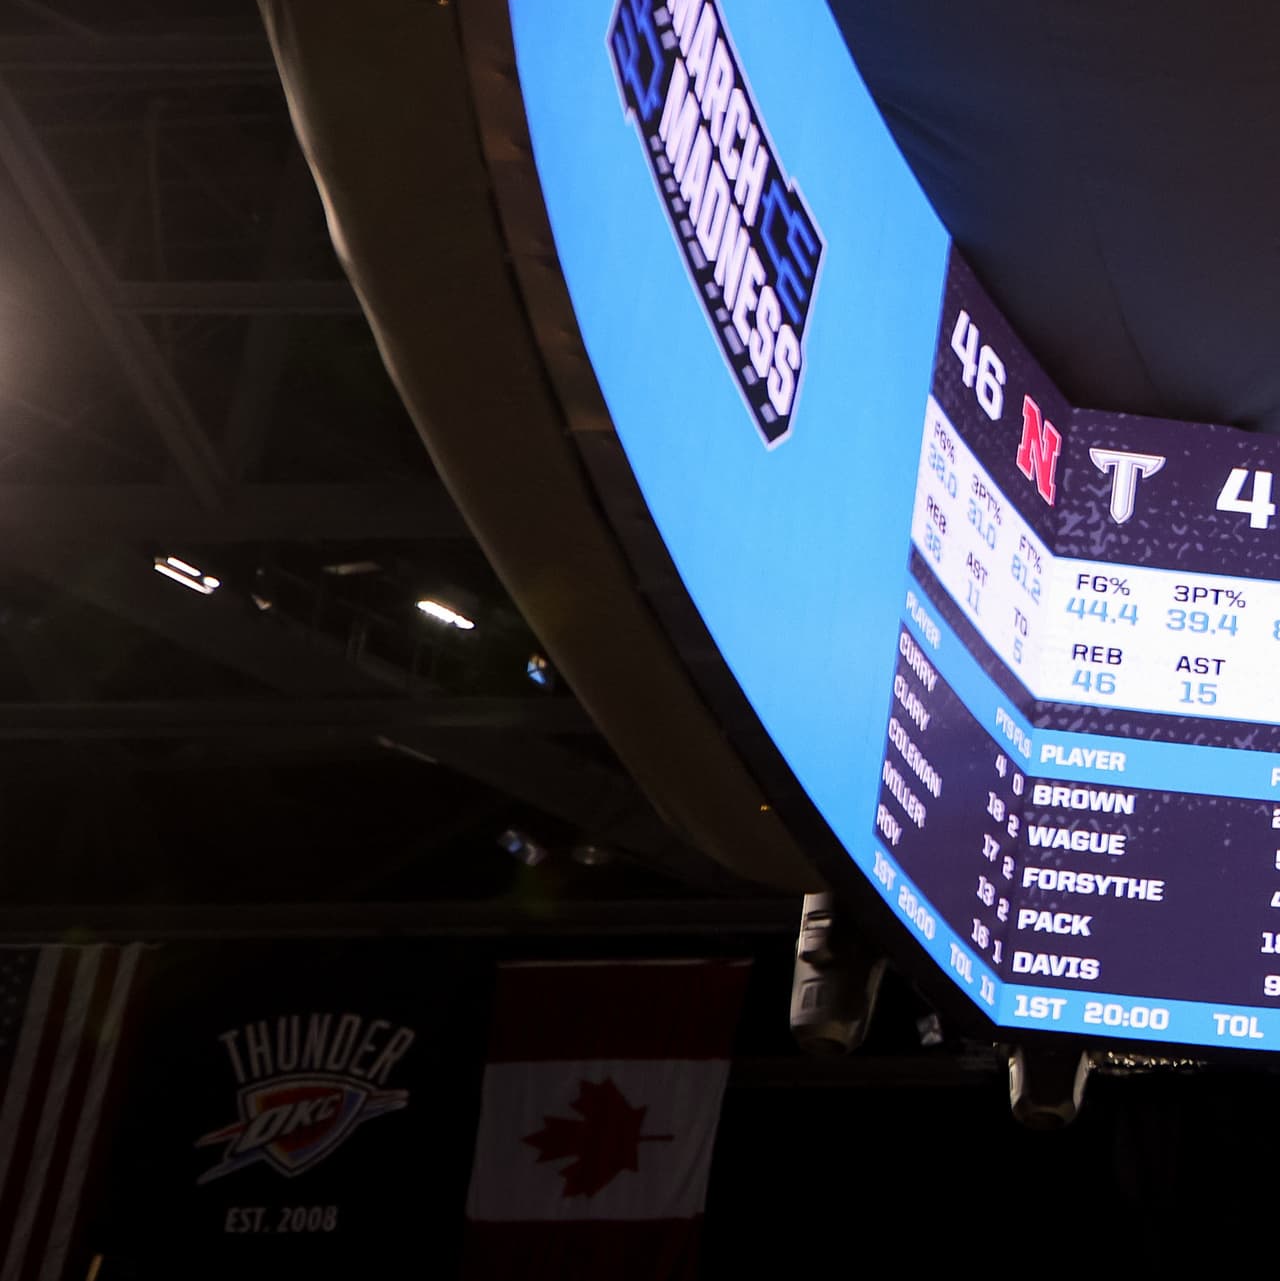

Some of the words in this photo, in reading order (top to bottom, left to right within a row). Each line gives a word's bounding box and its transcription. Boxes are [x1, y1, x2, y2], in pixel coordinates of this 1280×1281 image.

[659, 57, 801, 417] MADNESS
[951, 309, 1007, 422] 46
[1016, 393, 1063, 507] N
[1088, 448, 1167, 524] T
[1076, 573, 1132, 597] FG%
[1174, 584, 1247, 609] 3PT%
[1066, 596, 1140, 627] 44.4
[1165, 609, 1240, 637] 39.4
[900, 632, 938, 692] CURRY
[1072, 643, 1123, 667] REB
[1175, 655, 1226, 677] AST
[893, 675, 931, 732] CLARY
[1071, 670, 1118, 696] 46
[1179, 682, 1219, 706] 15
[888, 717, 942, 799] COLEMAN
[1040, 744, 1127, 772] PLAYER
[882, 760, 927, 829] MILLER
[1032, 784, 1136, 815] BROWN
[876, 803, 903, 847] ROY
[1027, 825, 1126, 856] WAGUE
[1022, 867, 1165, 902] FORSYTHE
[1017, 908, 1093, 937] PACK
[1012, 951, 1100, 981] DAVIS
[1014, 995, 1067, 1020] 1ST
[1083, 1002, 1170, 1031] 20:00
[1213, 1013, 1265, 1040] TOL
[218, 1013, 416, 1086] THUNDER
[224, 1207, 271, 1233] EST.
[277, 1206, 338, 1232] 2008
